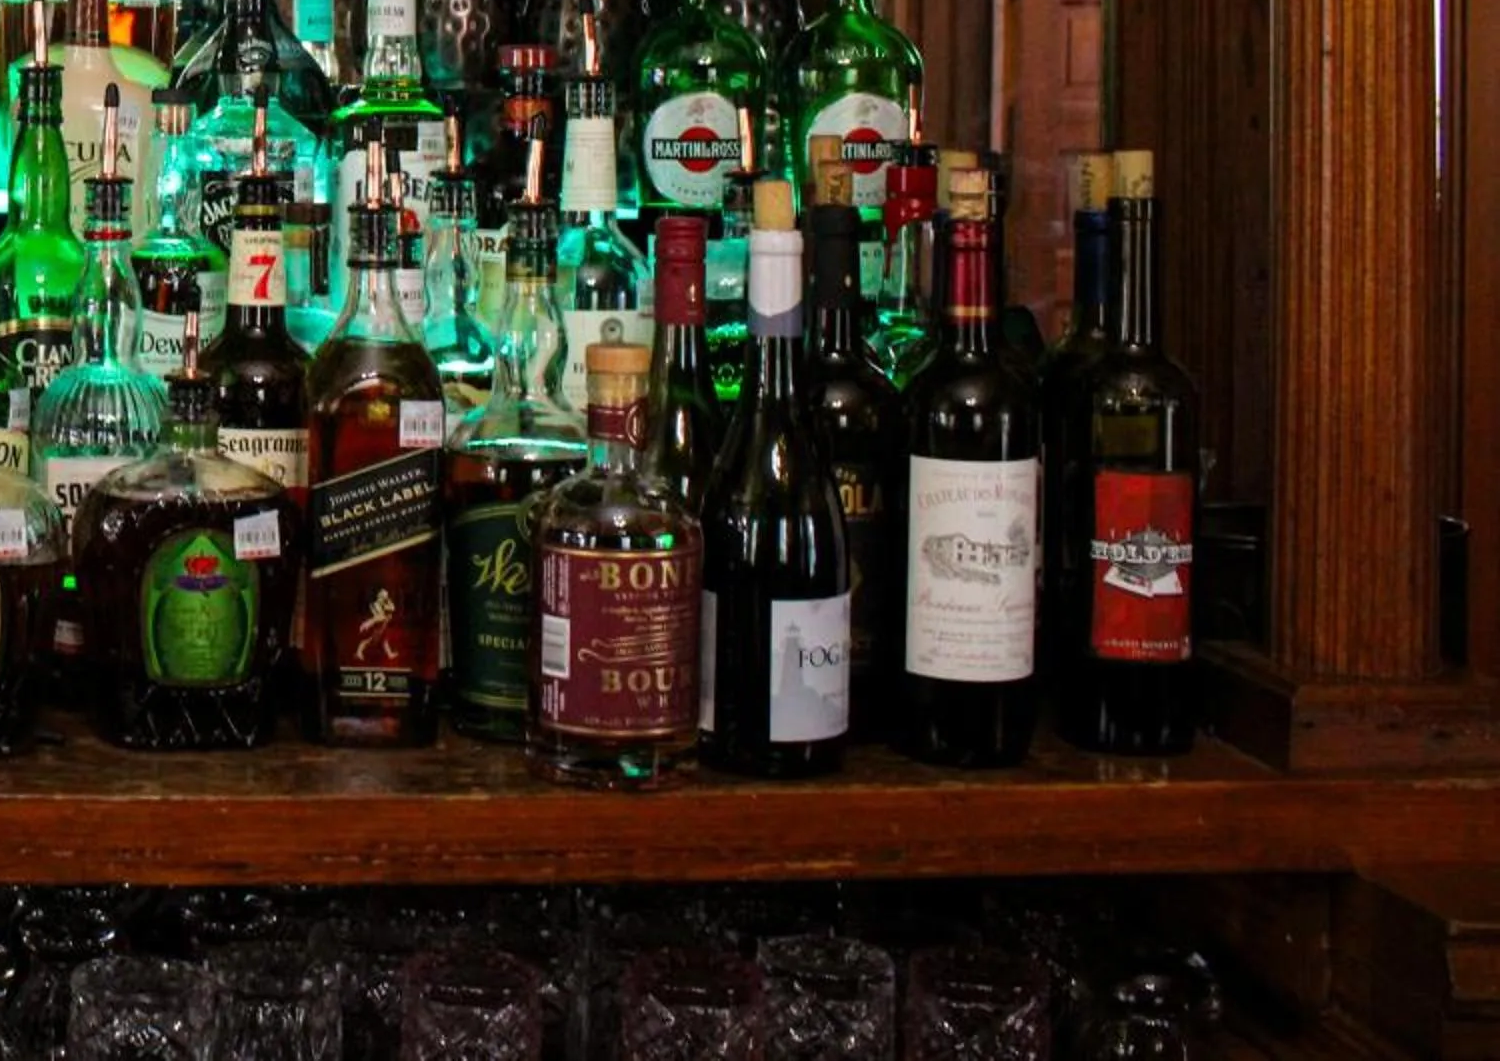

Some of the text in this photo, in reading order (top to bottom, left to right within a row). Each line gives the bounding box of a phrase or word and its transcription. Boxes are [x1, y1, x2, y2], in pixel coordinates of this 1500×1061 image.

[654, 141, 706, 158] MARTINI
[711, 141, 741, 157] ROSS
[250, 254, 277, 300] 7
[16, 338, 74, 365] CLAN
[321, 482, 438, 527] BLACK LABEL
[478, 634, 526, 650] SPECIA
[364, 671, 387, 692] 12
